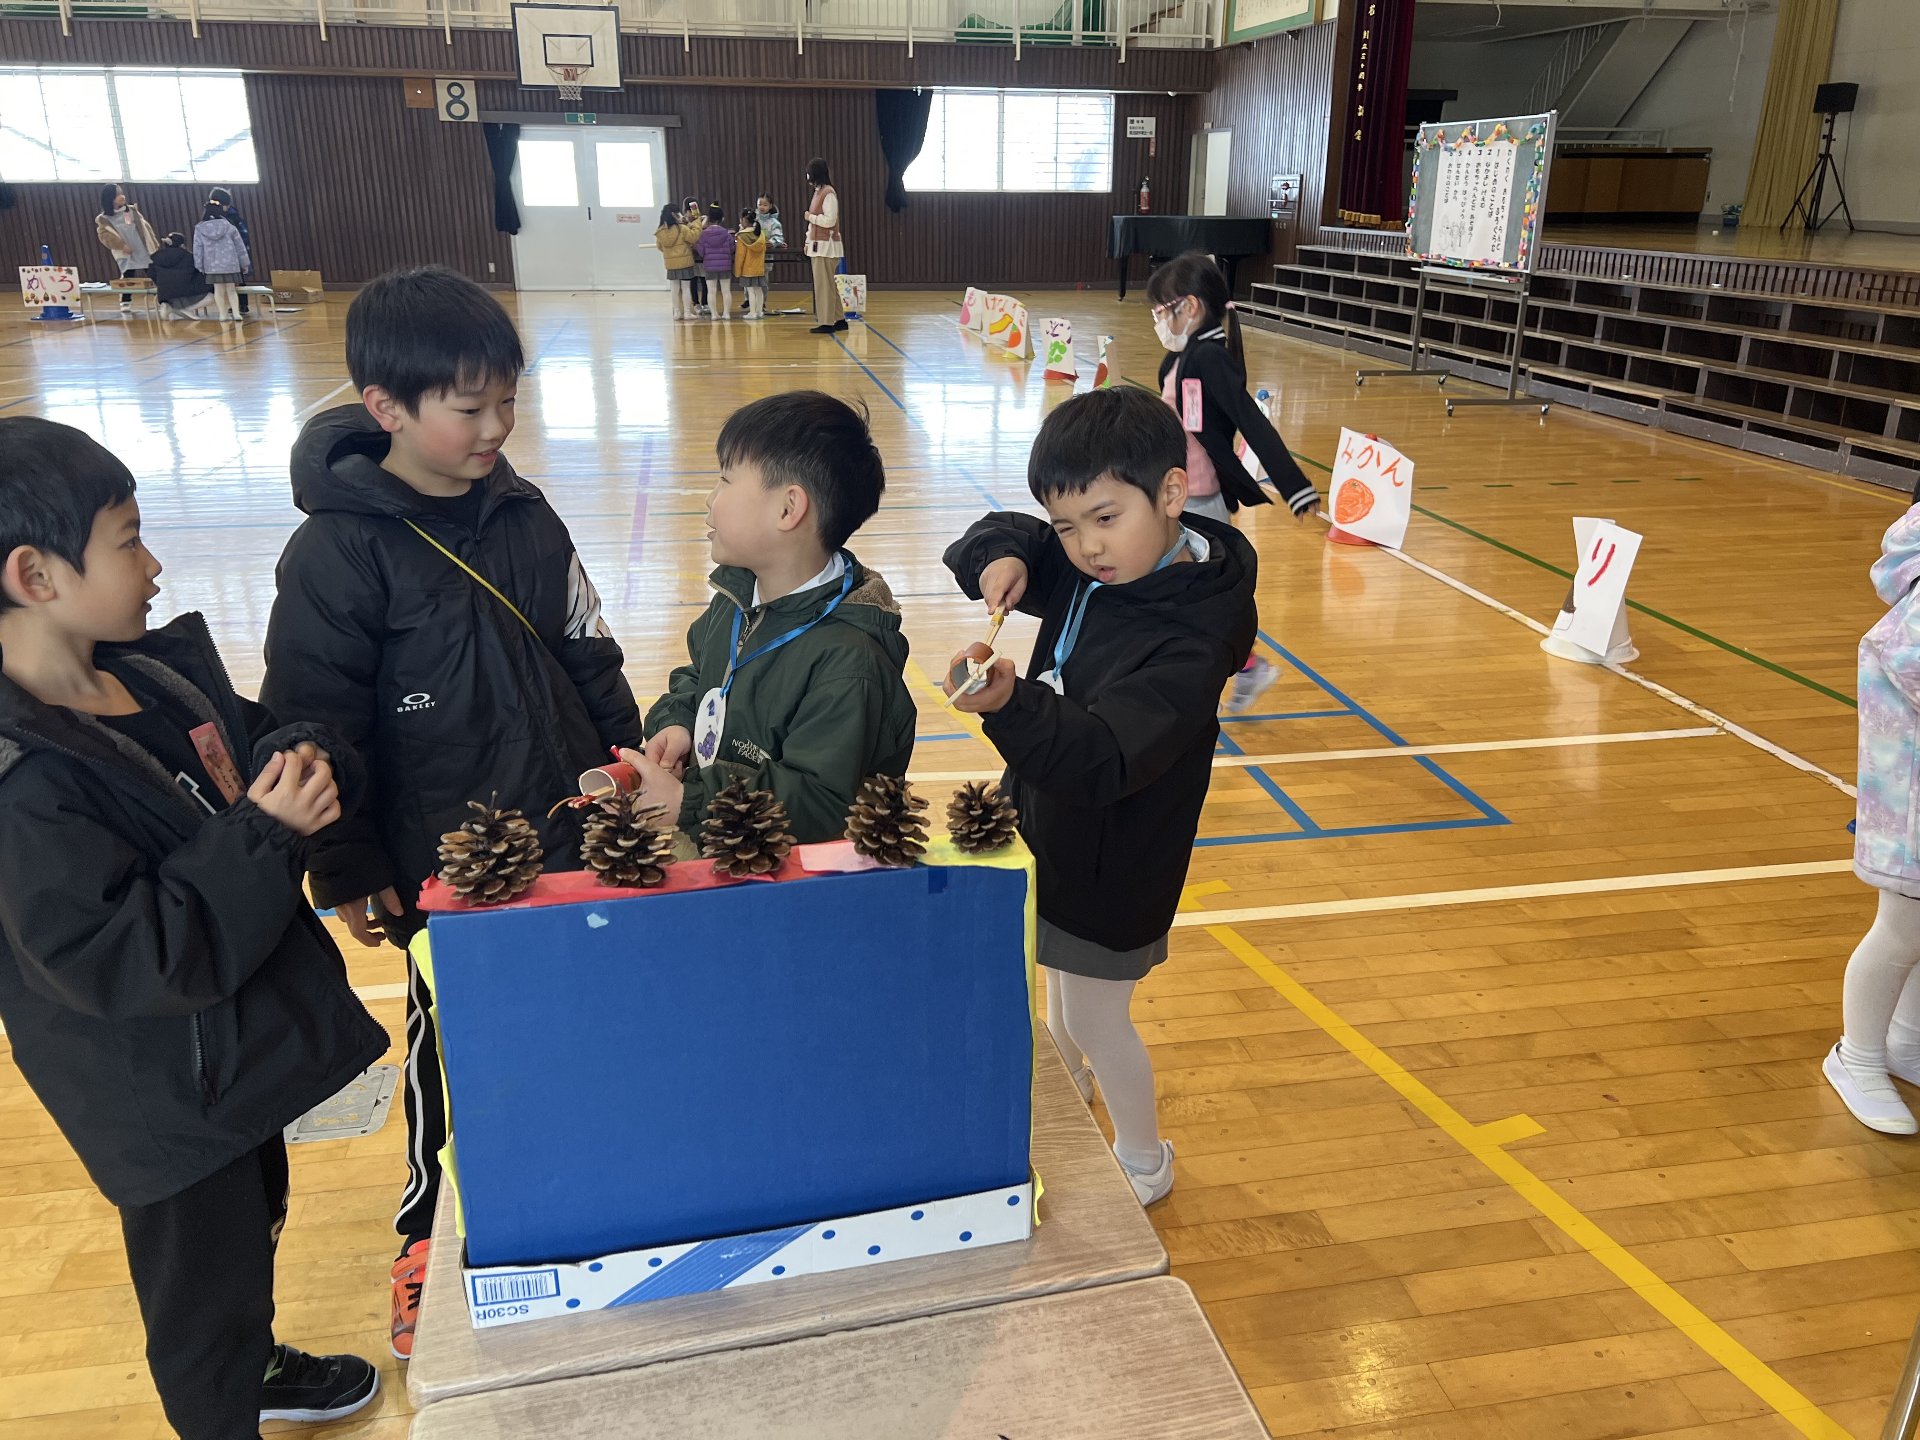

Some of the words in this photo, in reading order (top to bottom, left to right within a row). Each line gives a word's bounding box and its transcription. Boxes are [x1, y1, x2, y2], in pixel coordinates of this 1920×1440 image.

[445, 81, 470, 121] 8
[26, 275, 74, 293] めいろ
[1341, 436, 1405, 488] みかん
[396, 701, 436, 713] OAKLEY
[737, 747, 758, 763] FACE
